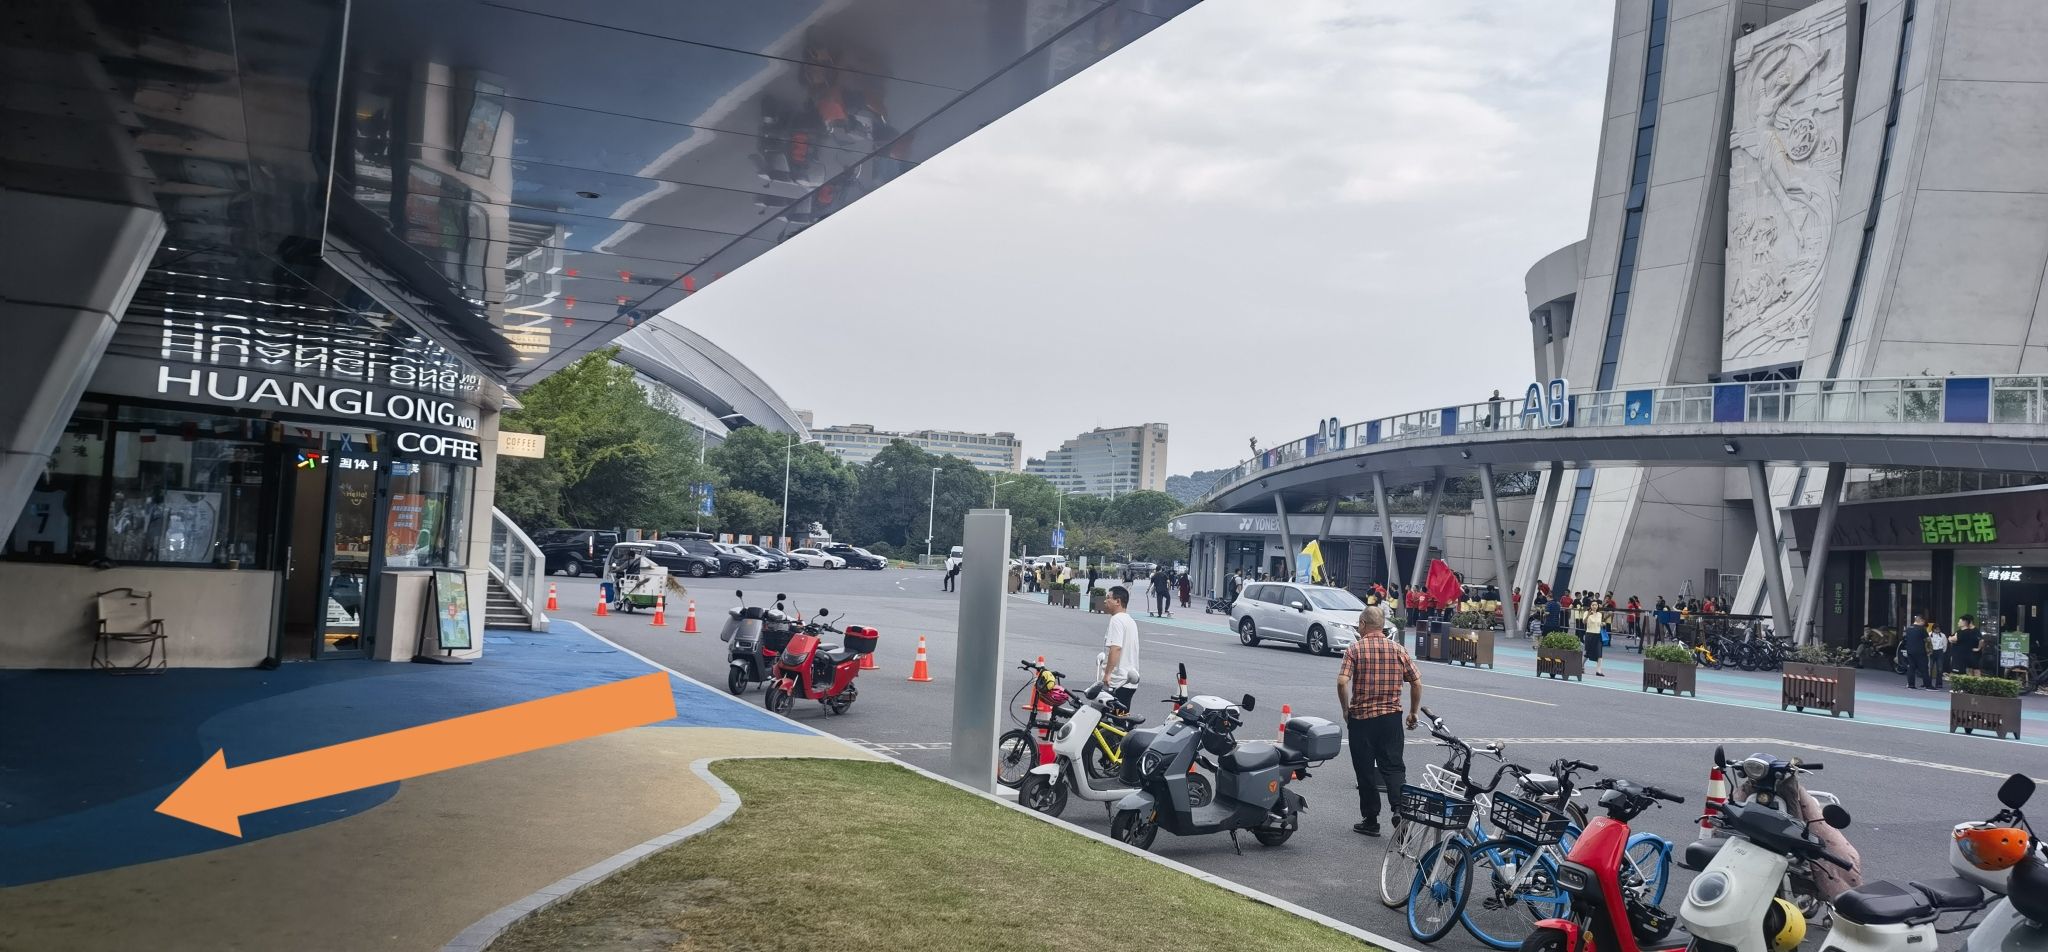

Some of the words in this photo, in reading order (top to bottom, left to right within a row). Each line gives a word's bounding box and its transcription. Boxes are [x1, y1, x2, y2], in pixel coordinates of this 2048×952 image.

[157, 366, 454, 426] HUANGLONG
[457, 416, 477, 430] NO.1
[1520, 378, 1569, 429] A8
[397, 431, 479, 461] COFFEE
[506, 437, 536, 448] COFFEE
[1314, 416, 1342, 455] A9
[1255, 518, 1281, 532] YONEX
[1918, 512, 1997, 544] 洛克兄弟
[1988, 569, 2023, 582] 维修区
